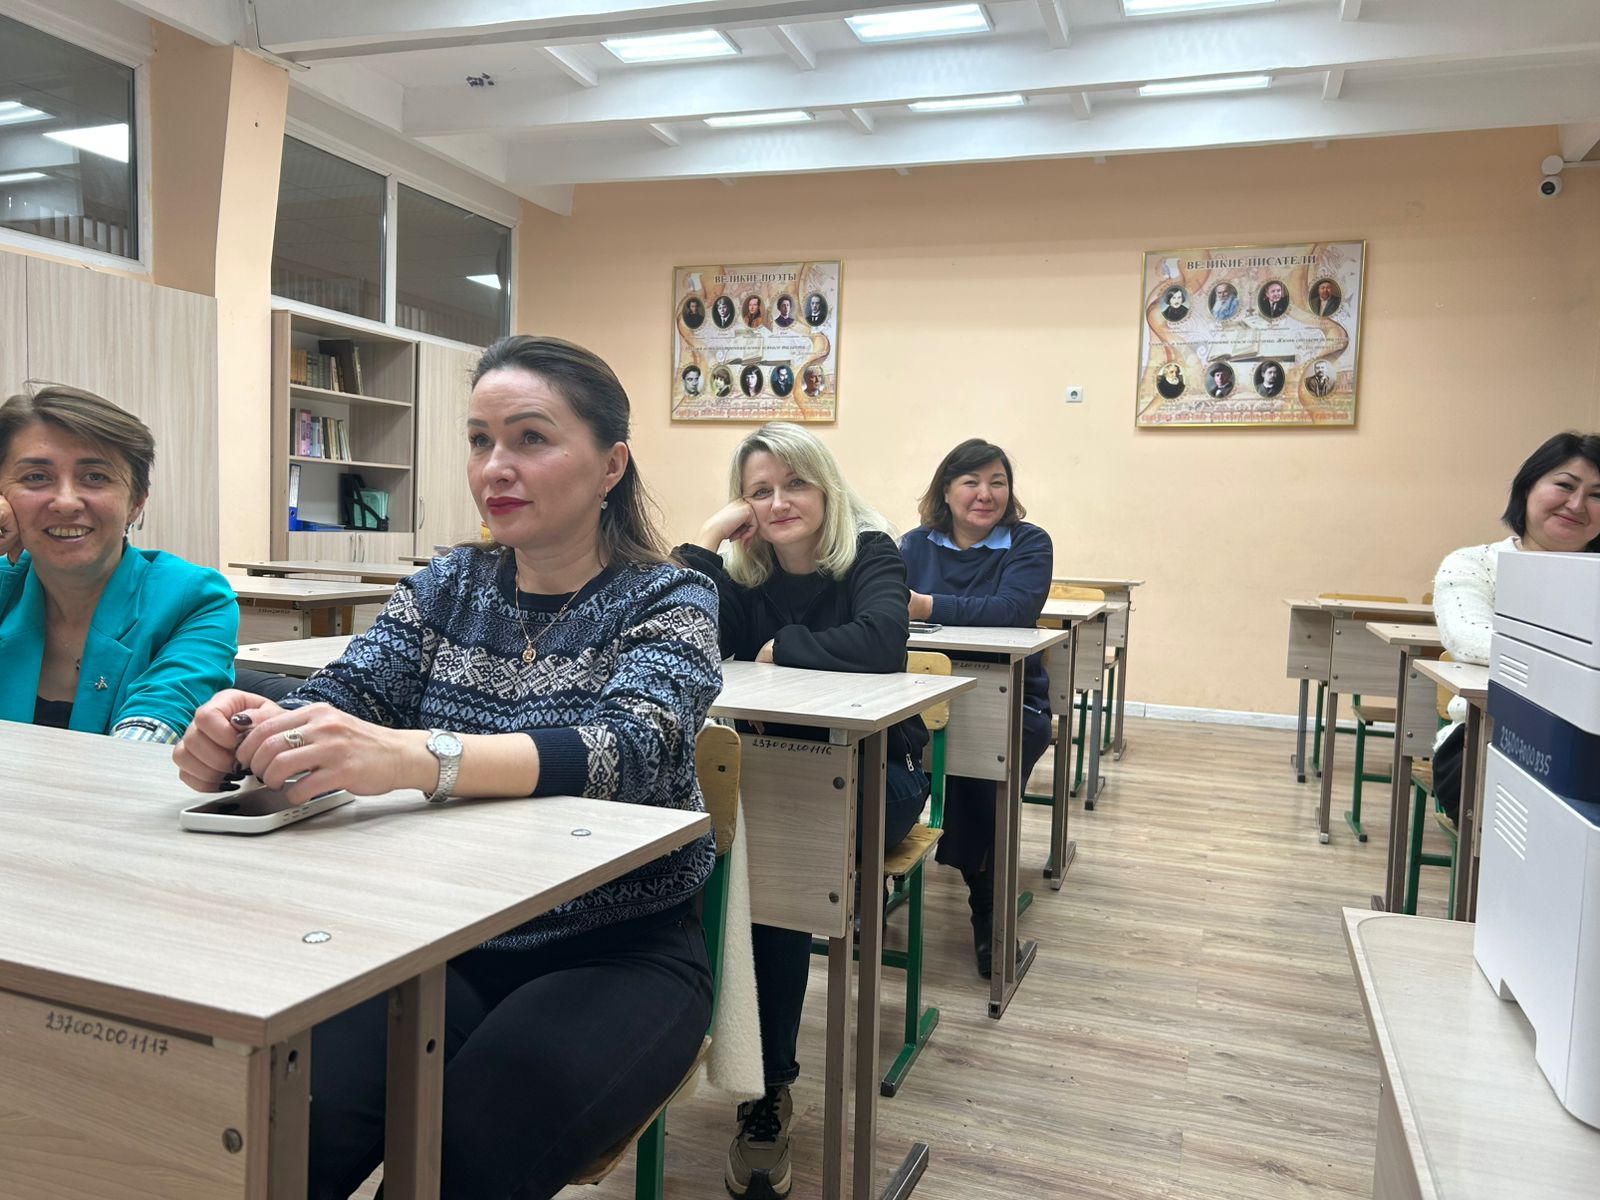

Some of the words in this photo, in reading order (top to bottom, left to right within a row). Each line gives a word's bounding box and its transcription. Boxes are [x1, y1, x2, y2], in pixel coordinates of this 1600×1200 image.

[1187, 257, 1244, 270] ВЕЛИКИЕ
[1248, 255, 1316, 267] ПИСАТЕЛИ
[714, 273, 758, 283] ВЕЛИКИЕ
[761, 272, 797, 282] ПОЭТЫ
[46, 1011, 168, 1056] 237002001117
